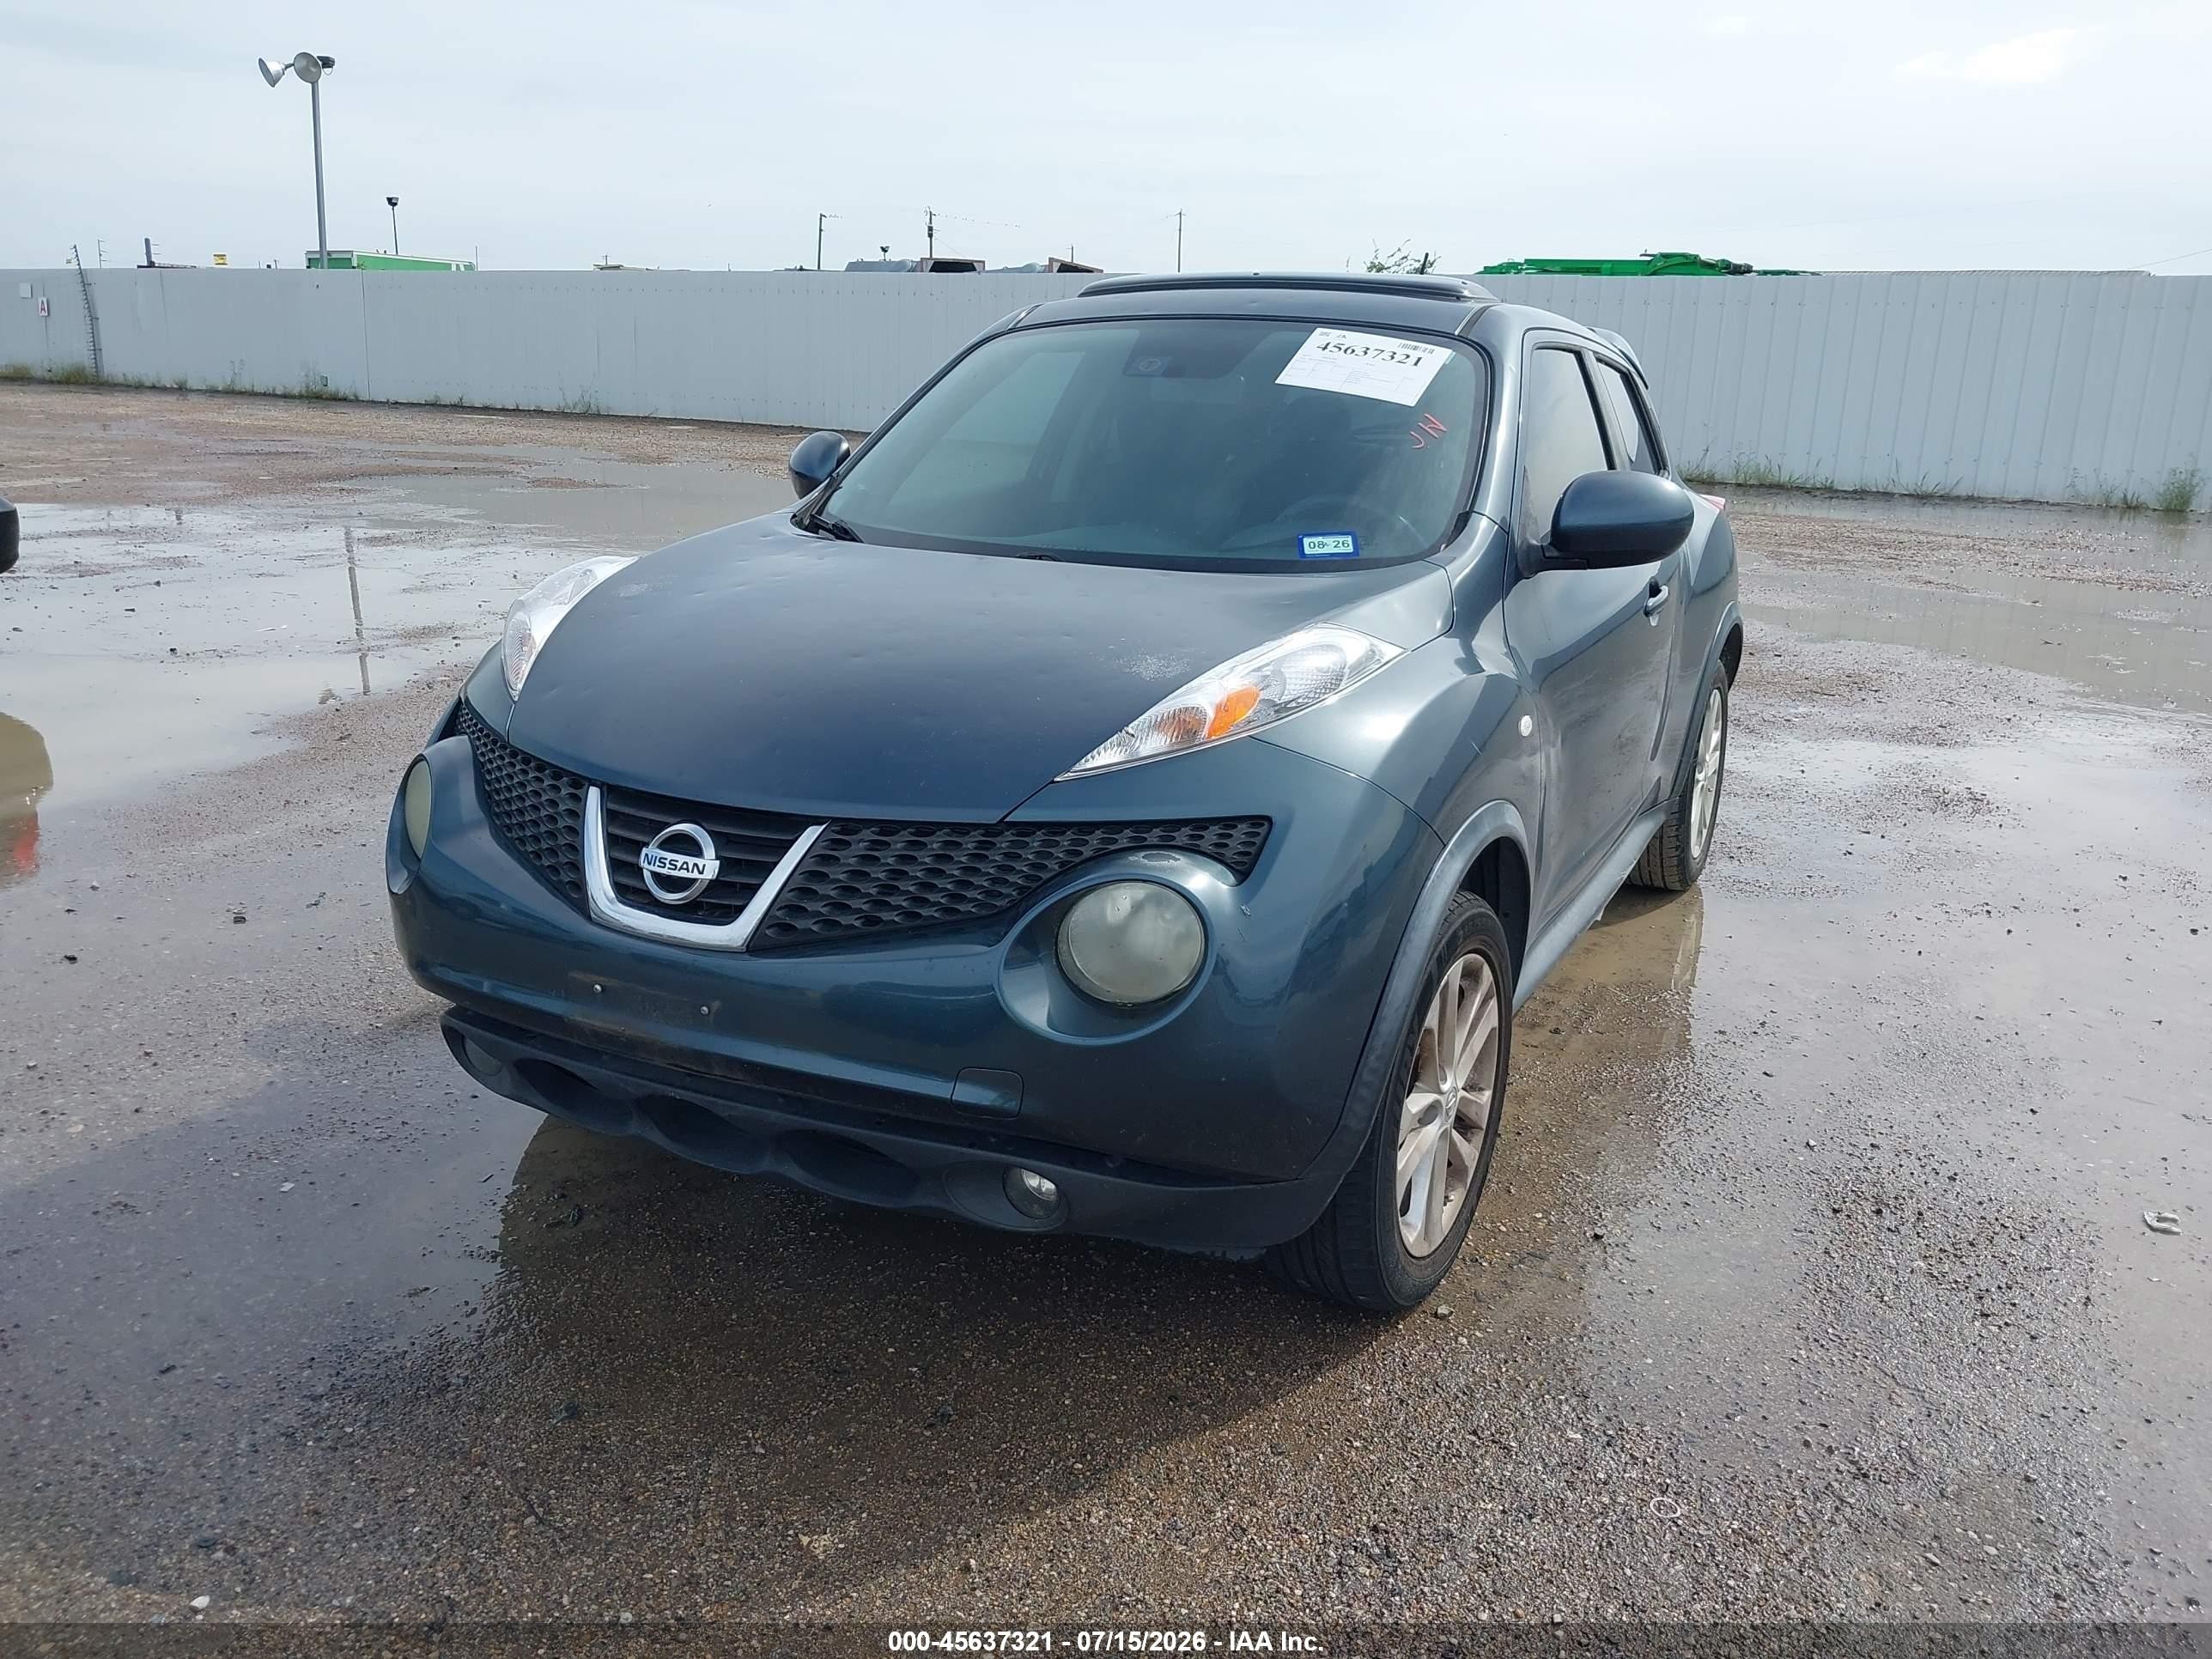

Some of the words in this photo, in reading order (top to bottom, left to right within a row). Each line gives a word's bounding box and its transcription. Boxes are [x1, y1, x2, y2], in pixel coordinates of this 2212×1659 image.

[40, 299, 47, 313] A
[1316, 341, 1424, 367] 45637321
[642, 853, 707, 876] NISSAN
